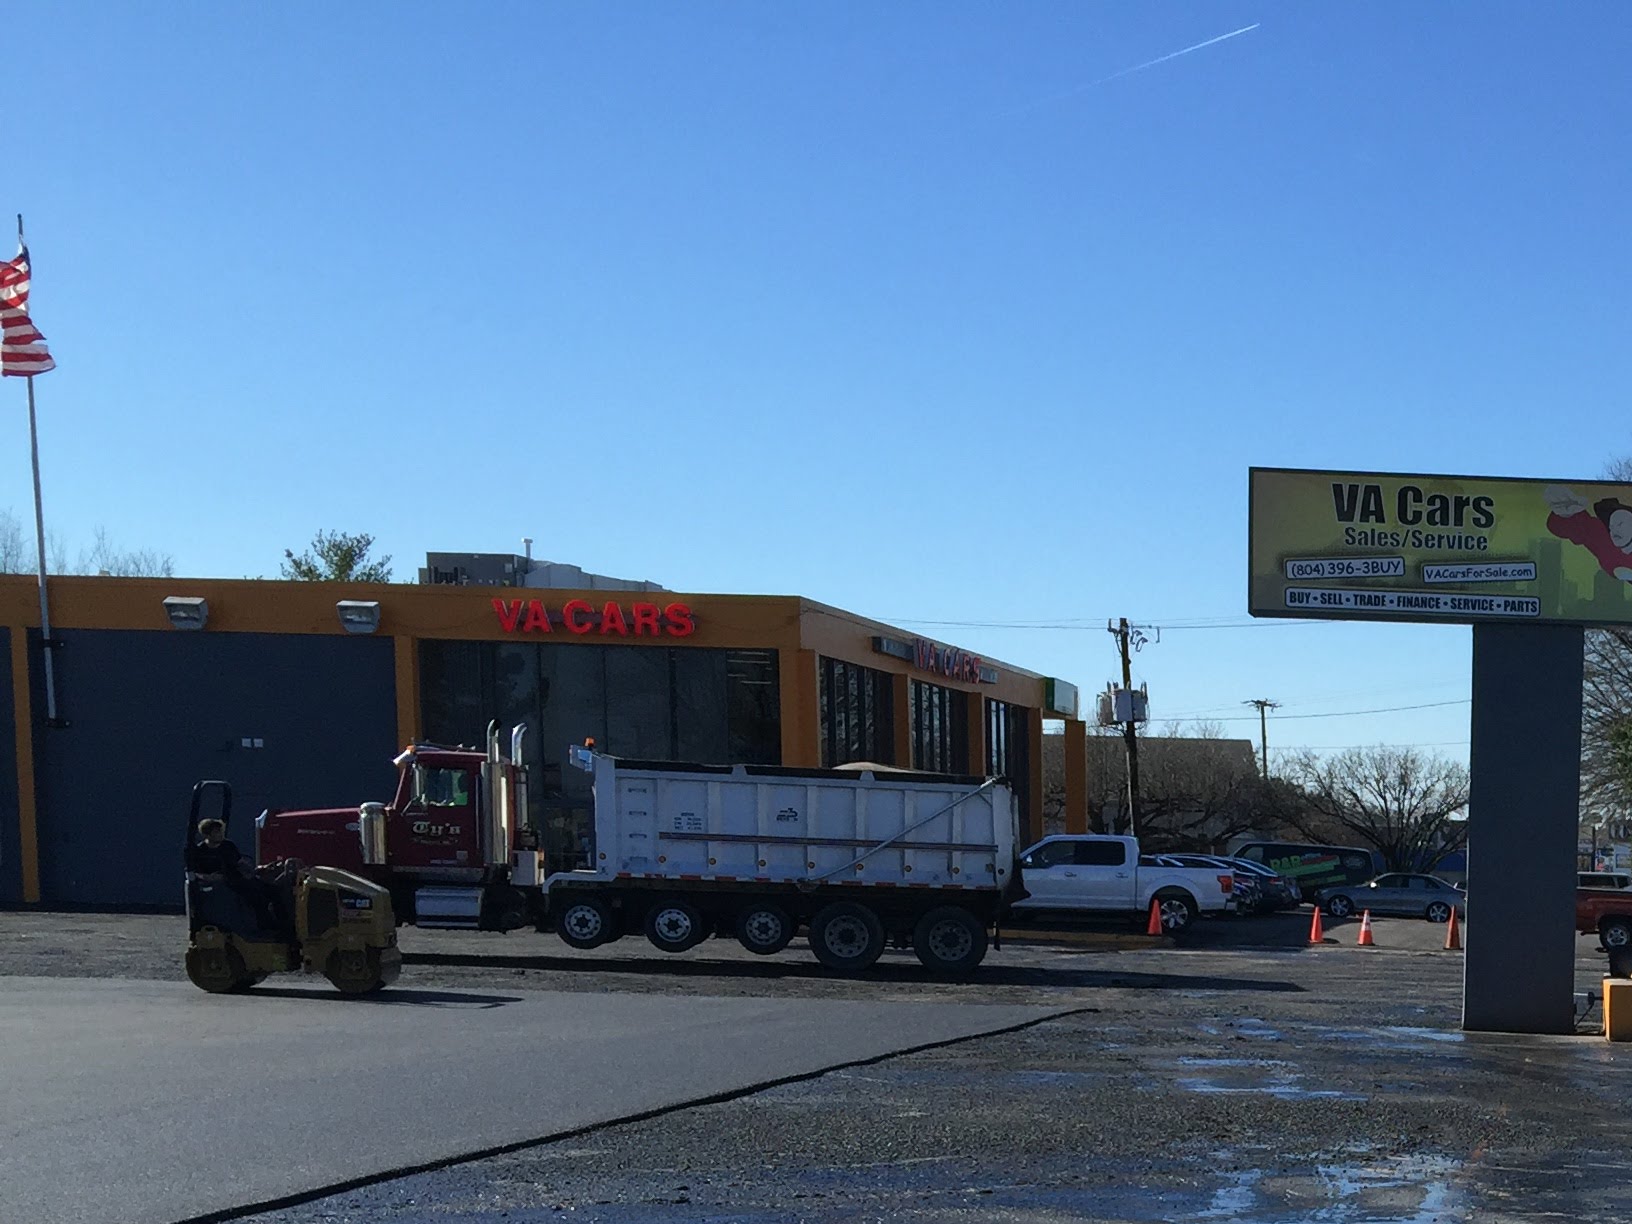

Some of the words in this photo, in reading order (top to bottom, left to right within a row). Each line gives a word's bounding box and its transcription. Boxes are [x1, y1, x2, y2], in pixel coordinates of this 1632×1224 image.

[1331, 483, 1386, 523] VA
[1397, 485, 1495, 529] Cars
[1344, 526, 1489, 551] Sales/Service
[1291, 562, 1325, 578] (804)
[1327, 559, 1402, 576] 396-3BUY
[1425, 566, 1533, 580] VACarsForSale.com
[1289, 591, 1312, 605] BUY
[1320, 592, 1344, 606] SELL
[1353, 593, 1387, 607] TRADE
[1397, 595, 1441, 610] FINANCE
[1450, 597, 1495, 612] SERVICE
[1503, 599, 1538, 613] PARTS
[491, 598, 553, 634] VA
[562, 600, 696, 637] CARS
[913, 638, 937, 673] VA
[941, 646, 982, 684] CARS
